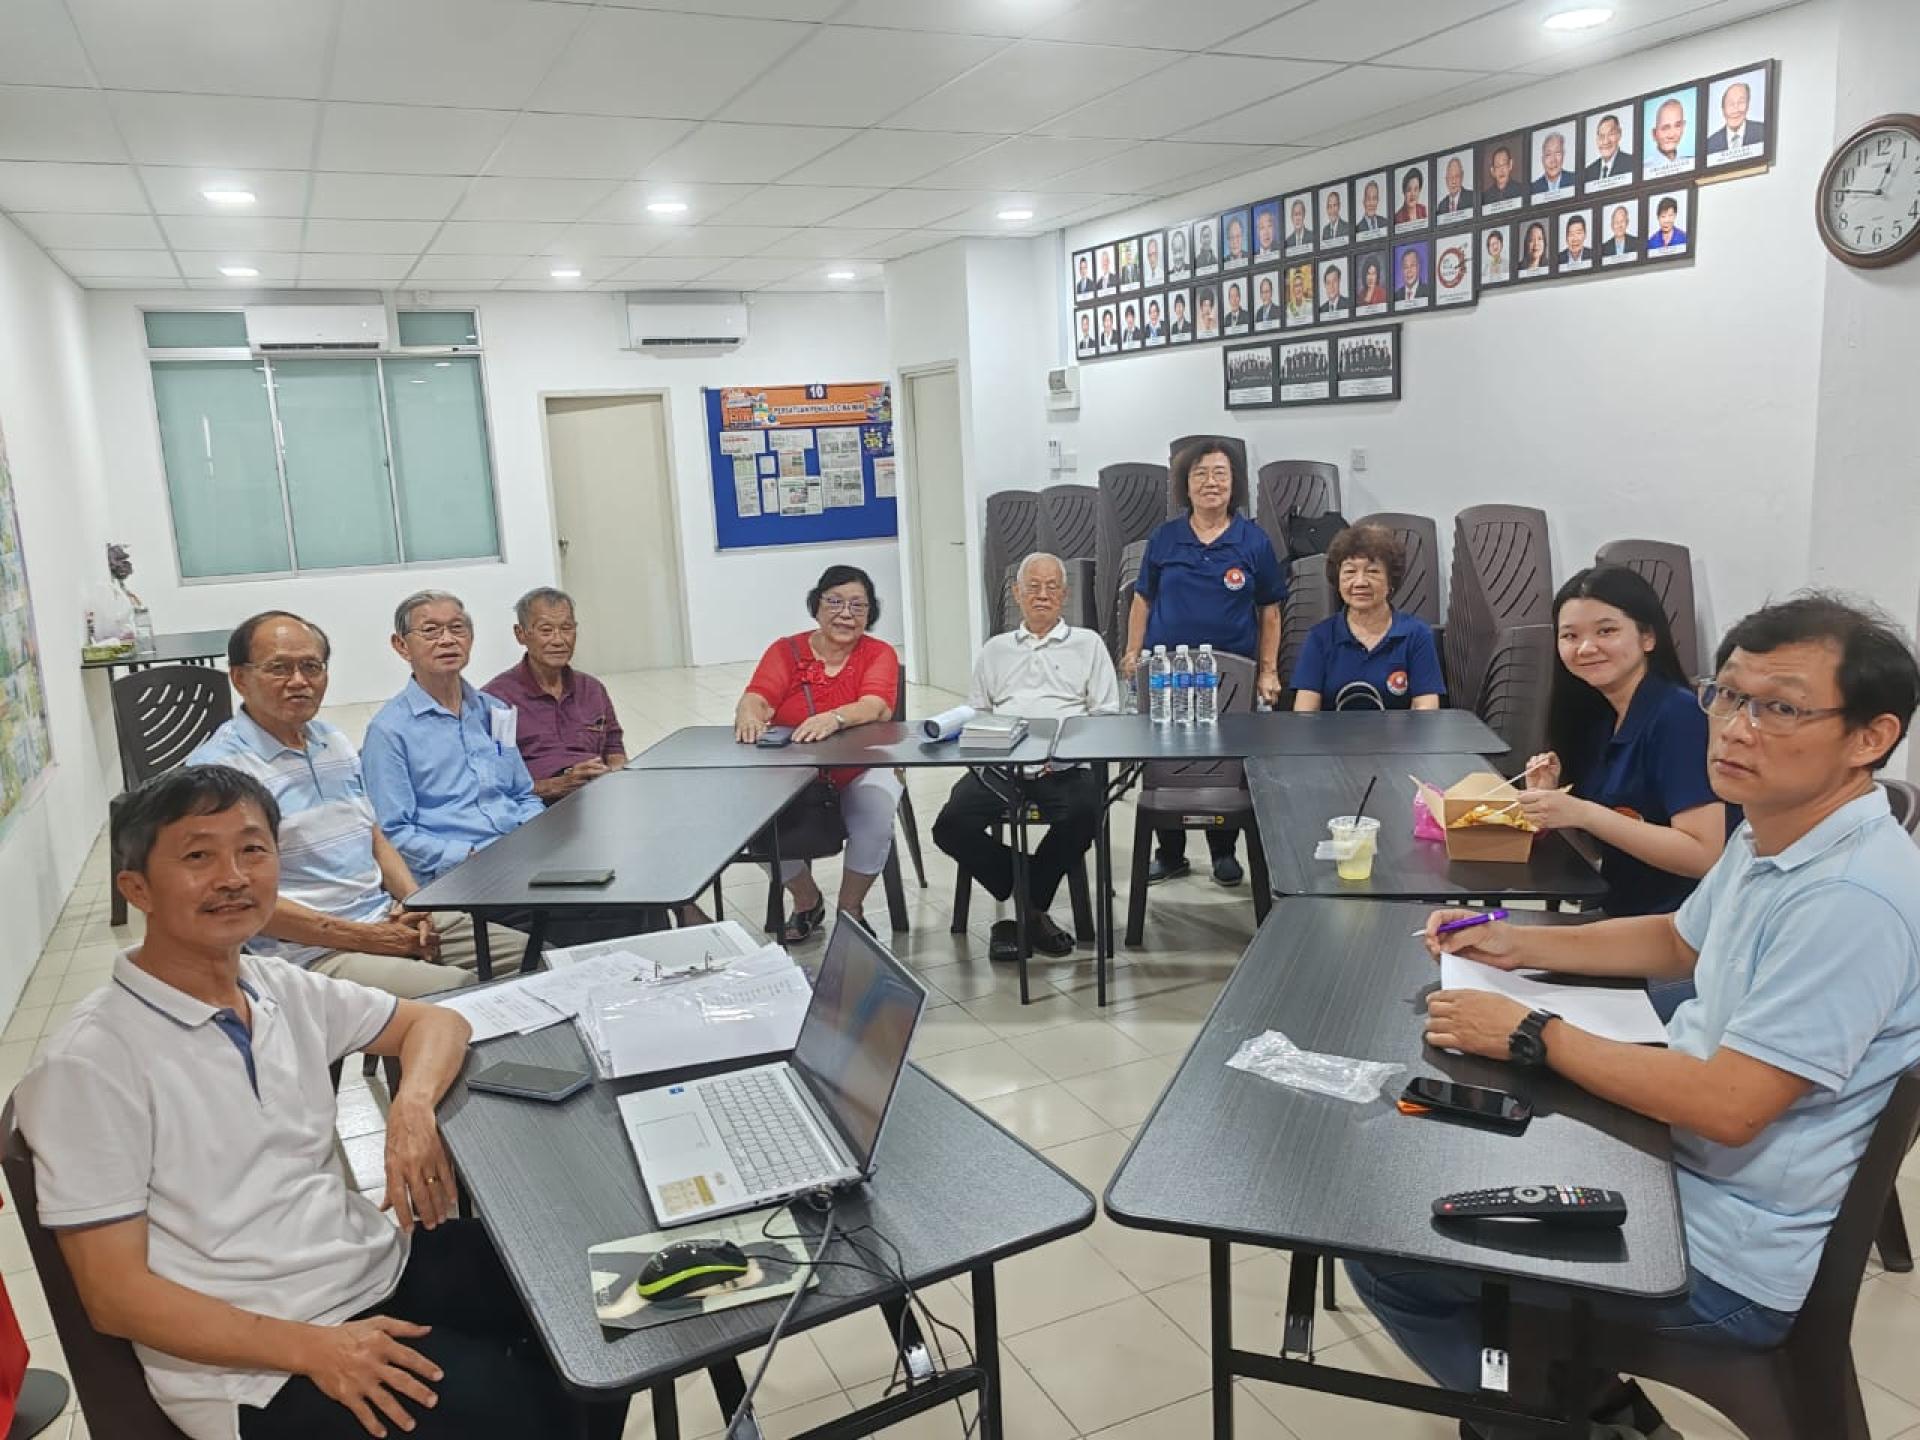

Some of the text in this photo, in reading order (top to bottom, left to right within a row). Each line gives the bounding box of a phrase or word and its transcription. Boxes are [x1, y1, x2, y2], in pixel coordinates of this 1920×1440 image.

[1877, 137, 1891, 156] 12
[1902, 140, 1908, 159] 1
[1857, 148, 1868, 167] 11
[1842, 168, 1855, 188] 10
[1908, 199, 1920, 219] 4
[1836, 213, 1849, 230] 8
[1891, 220, 1903, 239] 5
[1854, 225, 1866, 245] 7
[1871, 227, 1882, 245] 6
[809, 385, 825, 398] 10
